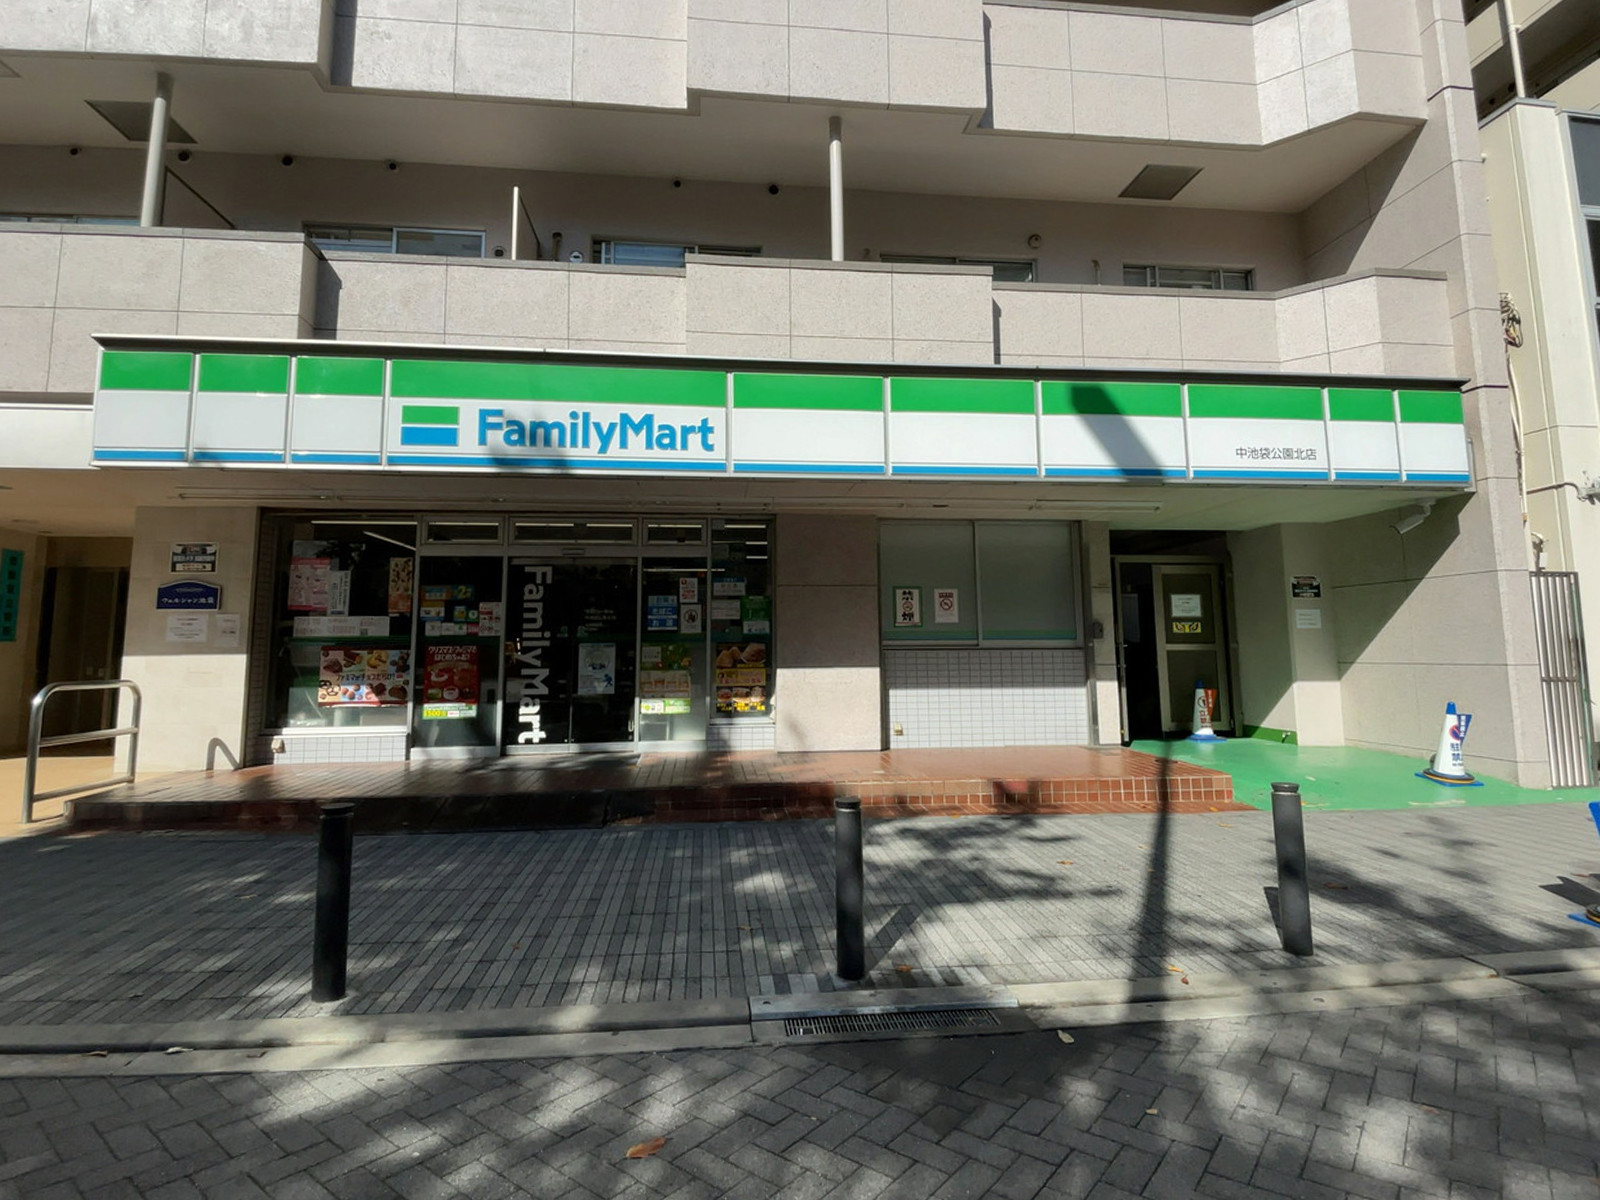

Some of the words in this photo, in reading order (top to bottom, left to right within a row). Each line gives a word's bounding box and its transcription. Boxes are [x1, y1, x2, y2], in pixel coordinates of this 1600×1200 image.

[478, 408, 715, 454] FamilyMart
[1235, 446, 1317, 461] 中池袋公園北店
[517, 565, 553, 743] FamilyMart
